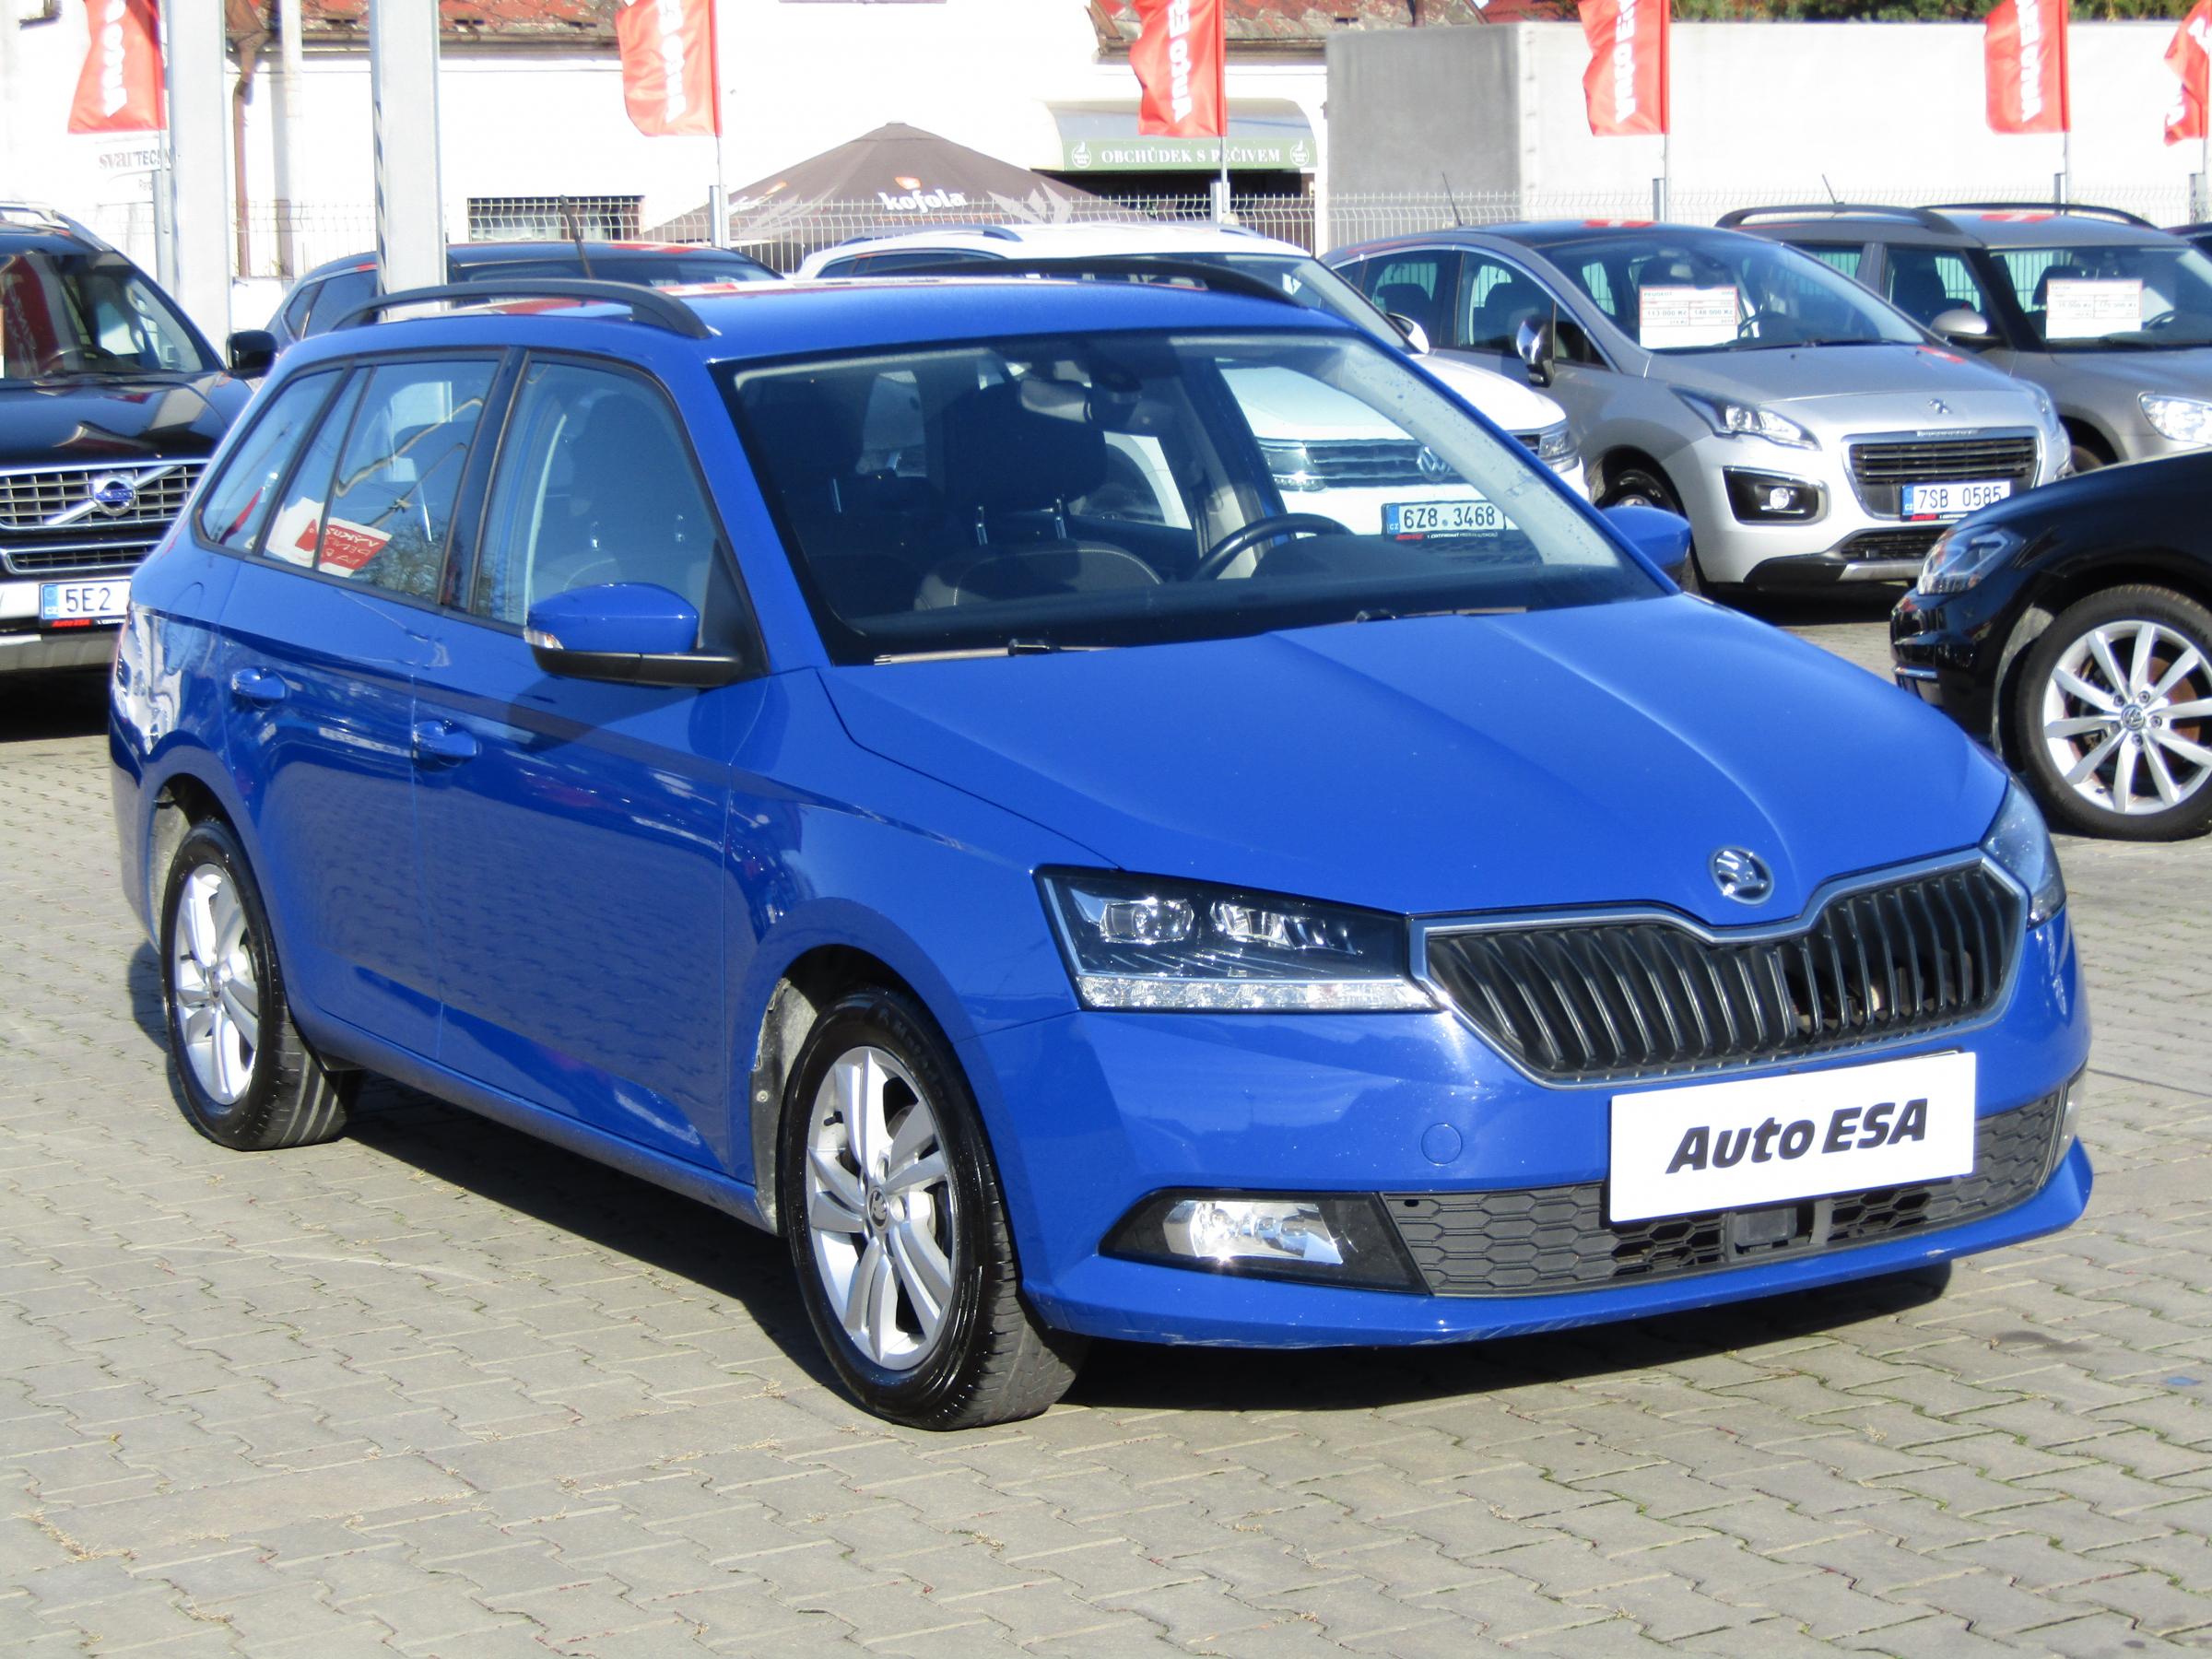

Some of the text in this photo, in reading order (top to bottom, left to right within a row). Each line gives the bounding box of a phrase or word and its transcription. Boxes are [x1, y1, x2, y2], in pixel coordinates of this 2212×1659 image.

[1101, 147, 1192, 164] OBCHŮDEK
[1197, 148, 1206, 163] S
[878, 189, 968, 213] kofola
[1919, 486, 2002, 510] 7SB 0585
[1404, 506, 1495, 529] 6Z8 3468
[65, 587, 112, 613] 5E2
[1665, 1098, 1928, 1174] Auto ESA
